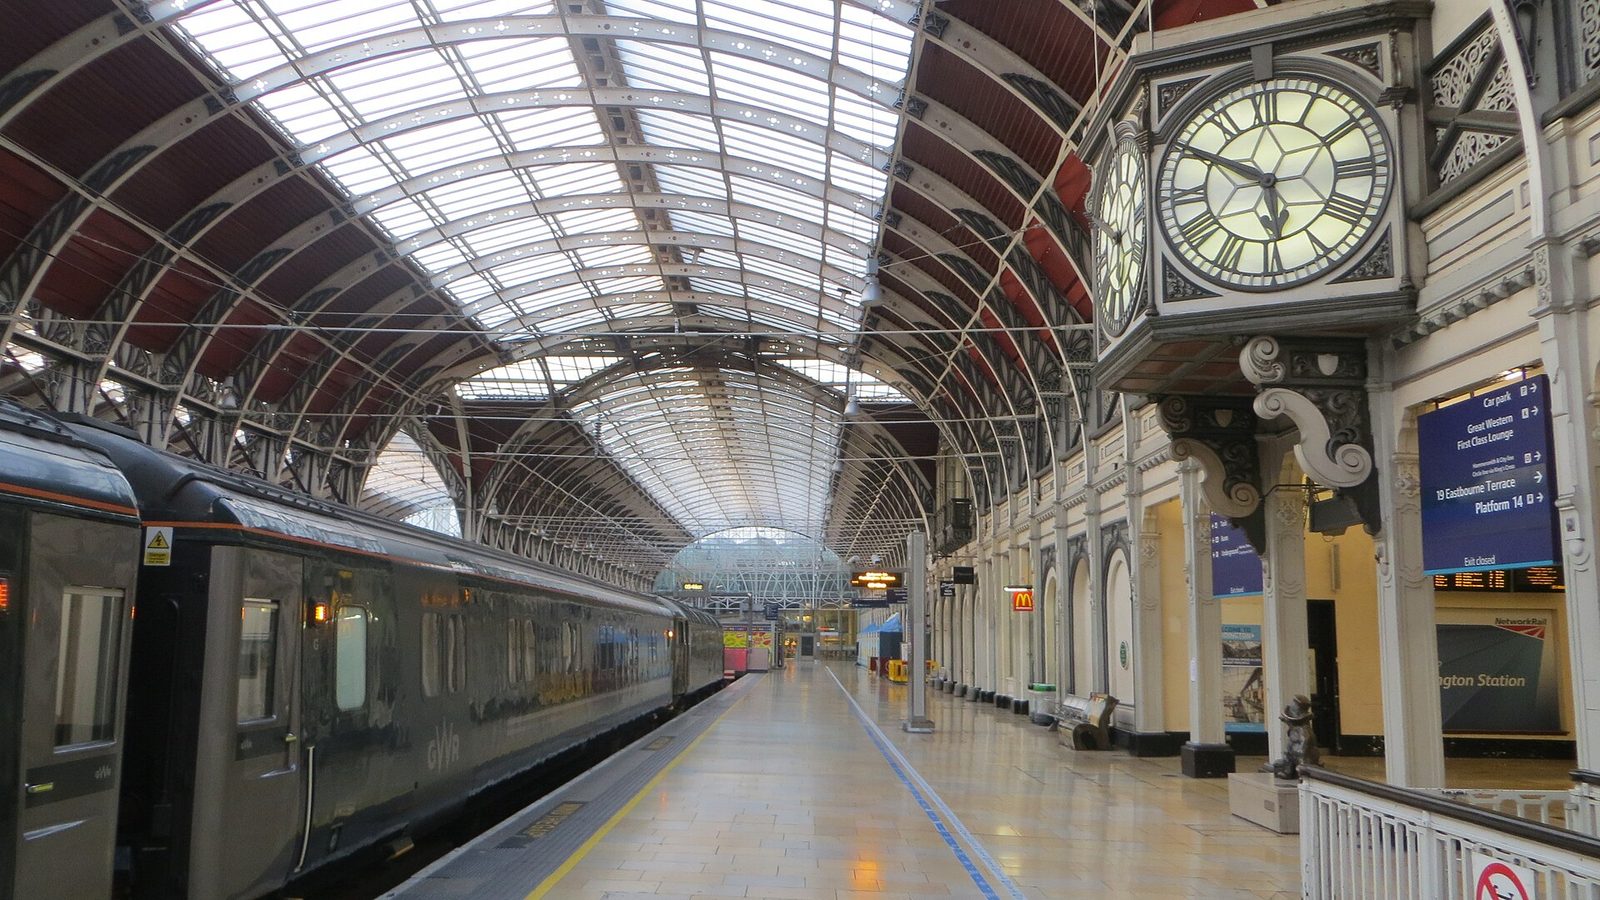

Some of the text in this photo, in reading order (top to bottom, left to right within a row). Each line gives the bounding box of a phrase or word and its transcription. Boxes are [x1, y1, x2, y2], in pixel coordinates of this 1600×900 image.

[1483, 391, 1511, 408] Car park
[1467, 414, 1514, 434] Great Western
[1457, 429, 1514, 450] First Class Lounge
[1436, 478, 1516, 501] 19 Eastbourne Terrace
[1475, 495, 1524, 514] Platform 14
[1464, 554, 1496, 566] Exit closed
[1477, 673, 1526, 687] Station
[428, 716, 460, 773] GWR
